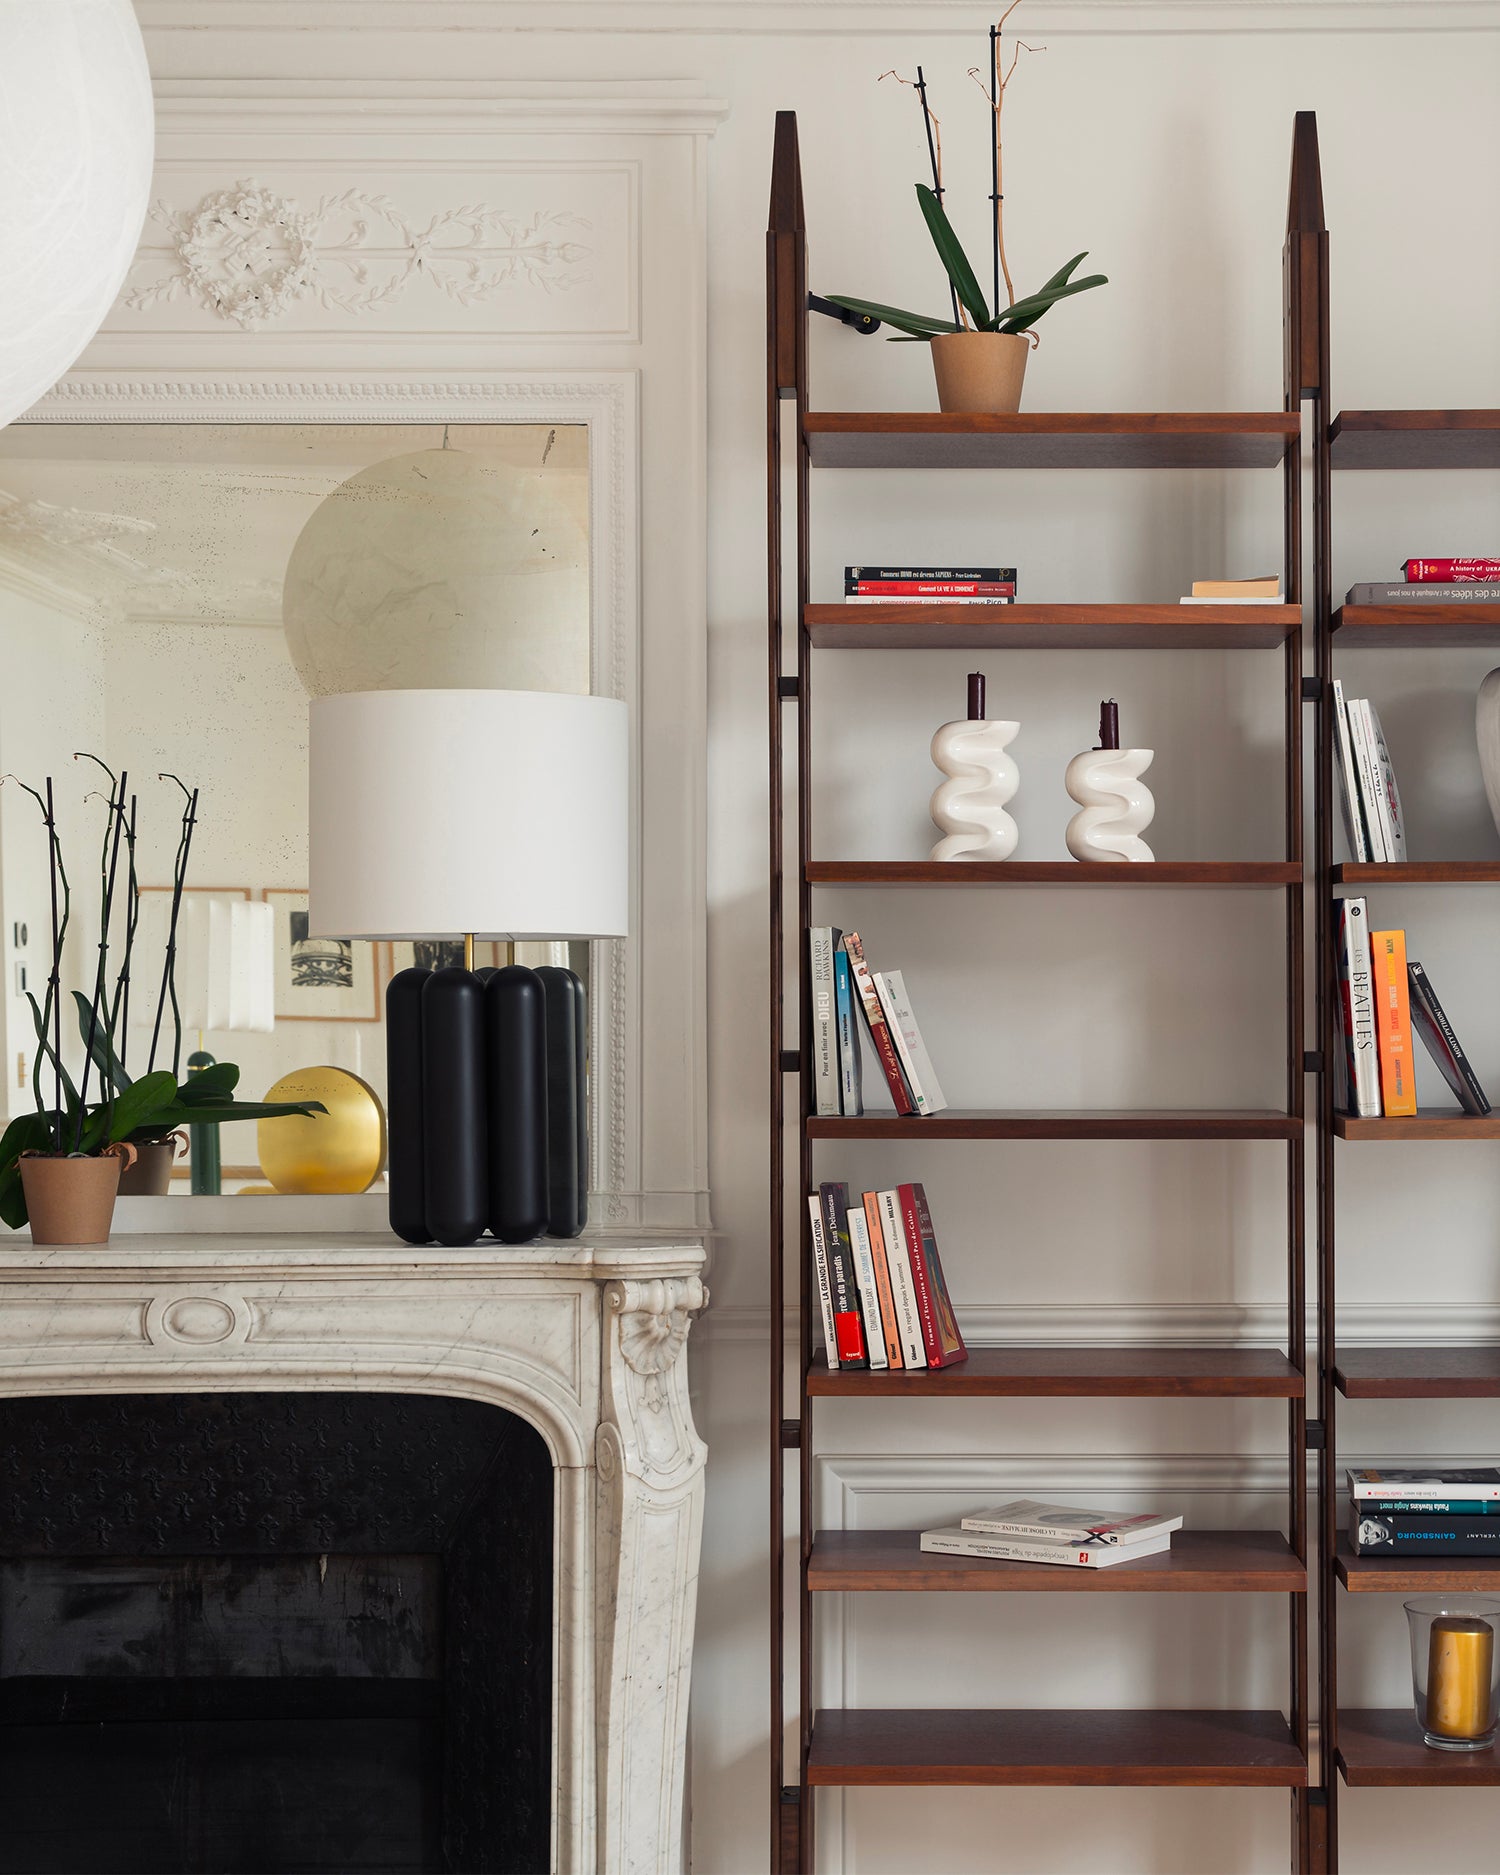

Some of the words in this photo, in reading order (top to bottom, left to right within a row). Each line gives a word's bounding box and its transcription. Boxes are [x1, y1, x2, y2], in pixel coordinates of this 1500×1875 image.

[1451, 590, 1472, 599] idées
[1474, 590, 1489, 598] des
[818, 992, 829, 1020] DIEU
[1353, 972, 1372, 1049] BEATLES
[823, 1052, 828, 1060] en
[1448, 1037, 1462, 1057] MONTY
[887, 1057, 896, 1066] soif
[889, 1068, 899, 1079] La
[886, 1196, 894, 1218] HILLARY
[814, 1219, 824, 1263] FALSIFICATION
[832, 1231, 840, 1245] Jean
[908, 1211, 921, 1270] Nord-Pas-de-Calais
[835, 1256, 845, 1282] paradis
[860, 1252, 869, 1274] SOMMET
[819, 1265, 828, 1291] GRANDE
[822, 1292, 829, 1300] LA
[838, 1285, 845, 1294] du
[866, 1288, 874, 1307] HILLARY
[921, 1283, 929, 1319] d'Exception
[868, 1309, 877, 1331] EDMUND
[904, 1308, 912, 1325] regard
[907, 1326, 913, 1334] Un
[1396, 1532, 1456, 1540] GAINSBOURG
